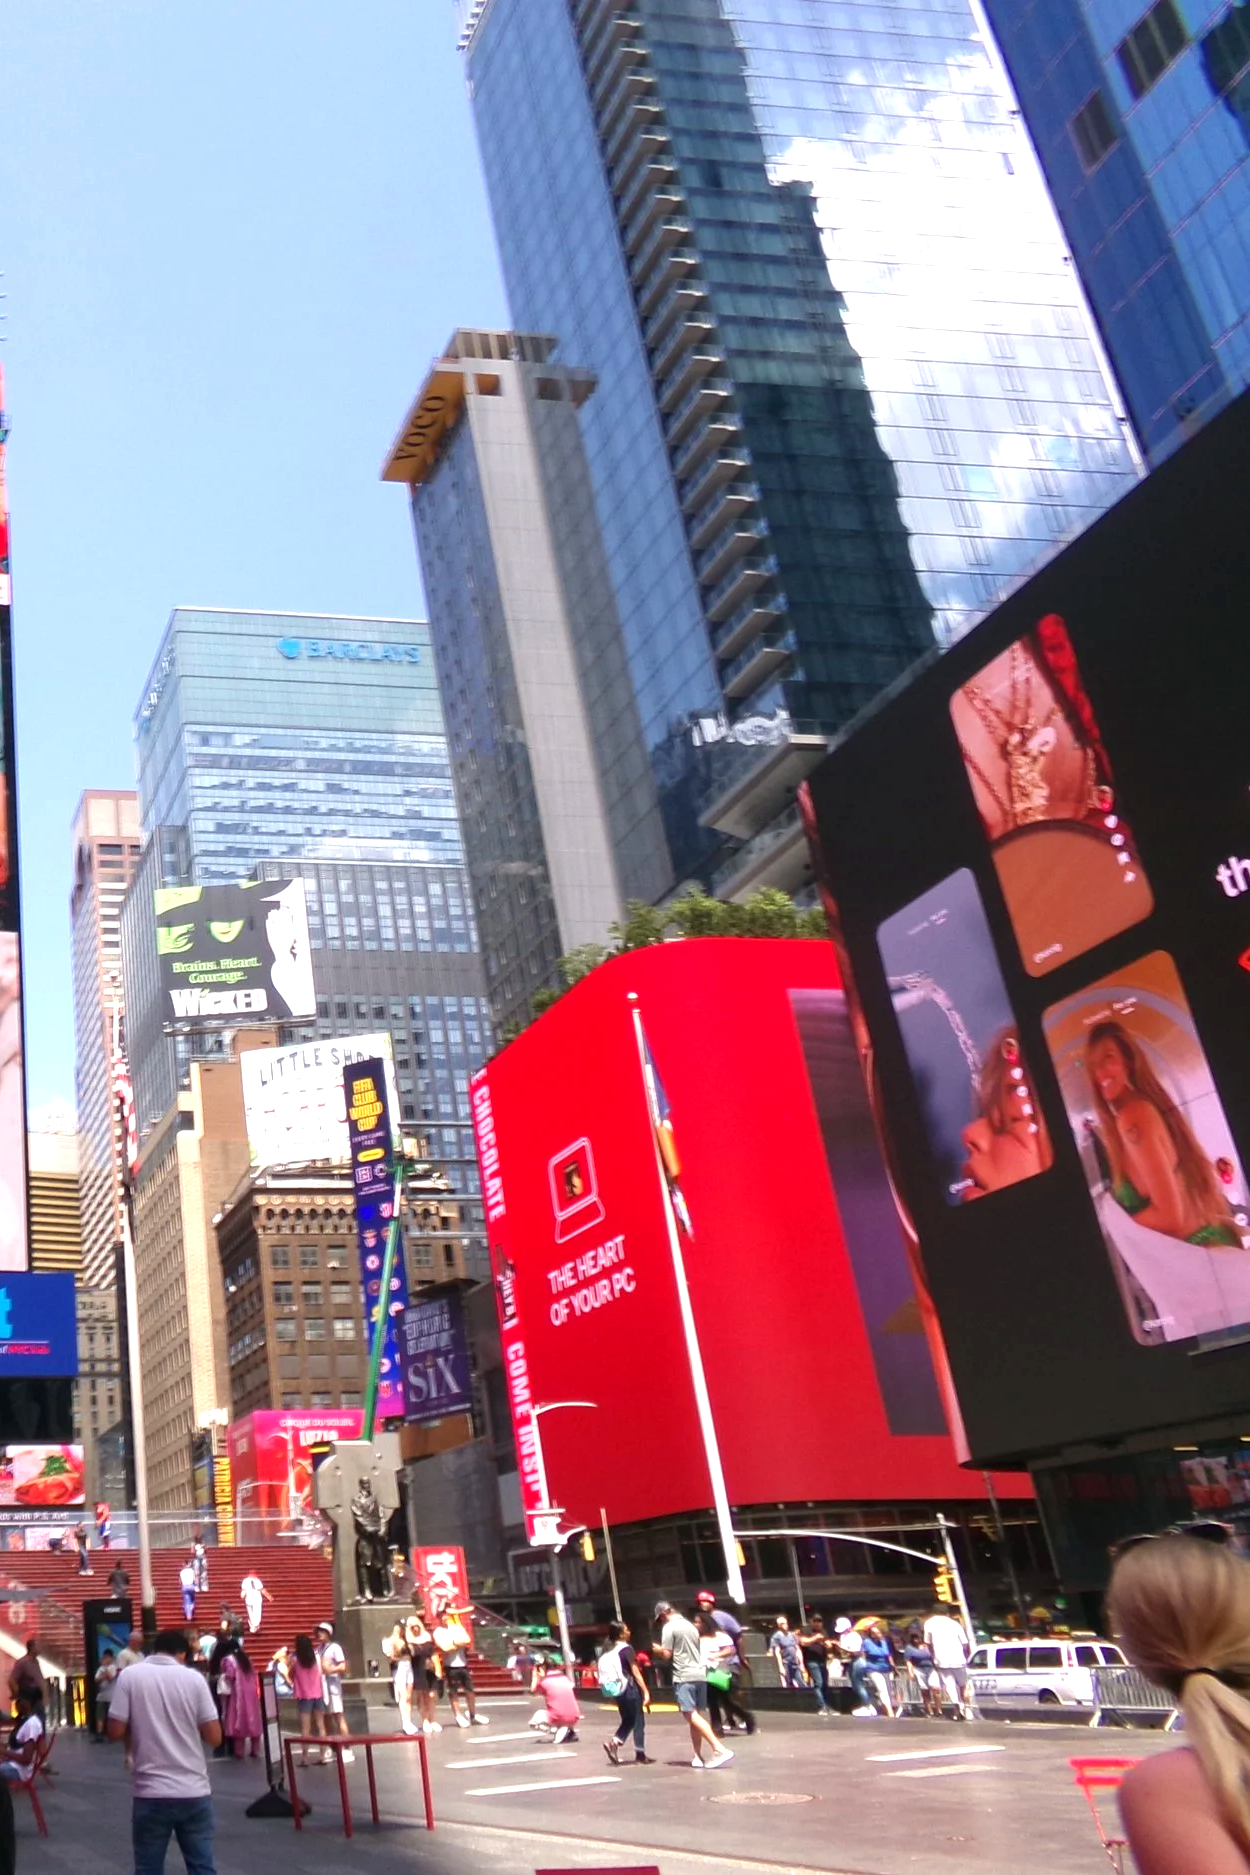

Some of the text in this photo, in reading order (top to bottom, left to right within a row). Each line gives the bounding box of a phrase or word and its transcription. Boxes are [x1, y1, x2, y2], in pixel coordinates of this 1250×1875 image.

[307, 640, 421, 664] BARCLAYS
[260, 1047, 323, 1087] LITTLE
[349, 1101, 384, 1121] WORLD
[353, 1090, 377, 1106] CLUB
[357, 1115, 379, 1131] CUP
[473, 1085, 507, 1223] CHOCOLATE
[547, 1234, 625, 1295] THE HEART
[550, 1267, 637, 1326] OF YOUR PC
[407, 1354, 463, 1404] SIX
[507, 1341, 533, 1419] COME
[213, 1457, 232, 1504] PATRICIA
